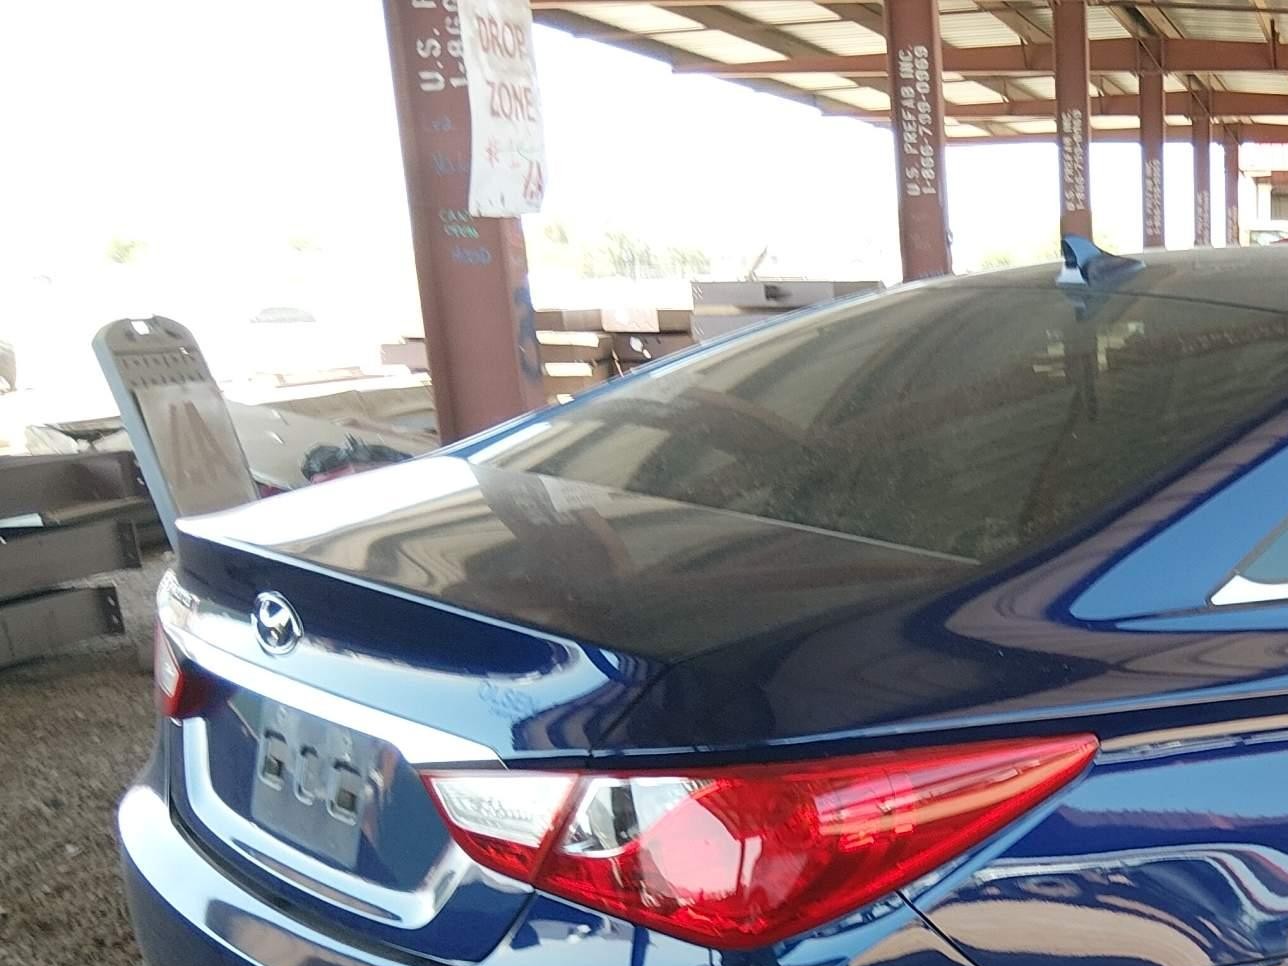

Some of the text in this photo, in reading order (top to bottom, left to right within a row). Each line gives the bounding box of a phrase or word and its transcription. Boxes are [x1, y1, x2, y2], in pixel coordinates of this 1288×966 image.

[475, 14, 527, 58] DROP
[416, 27, 446, 91] U.S.
[898, 44, 914, 79] INC.
[485, 79, 537, 122] ZONE
[901, 86, 919, 155] PREFAB
